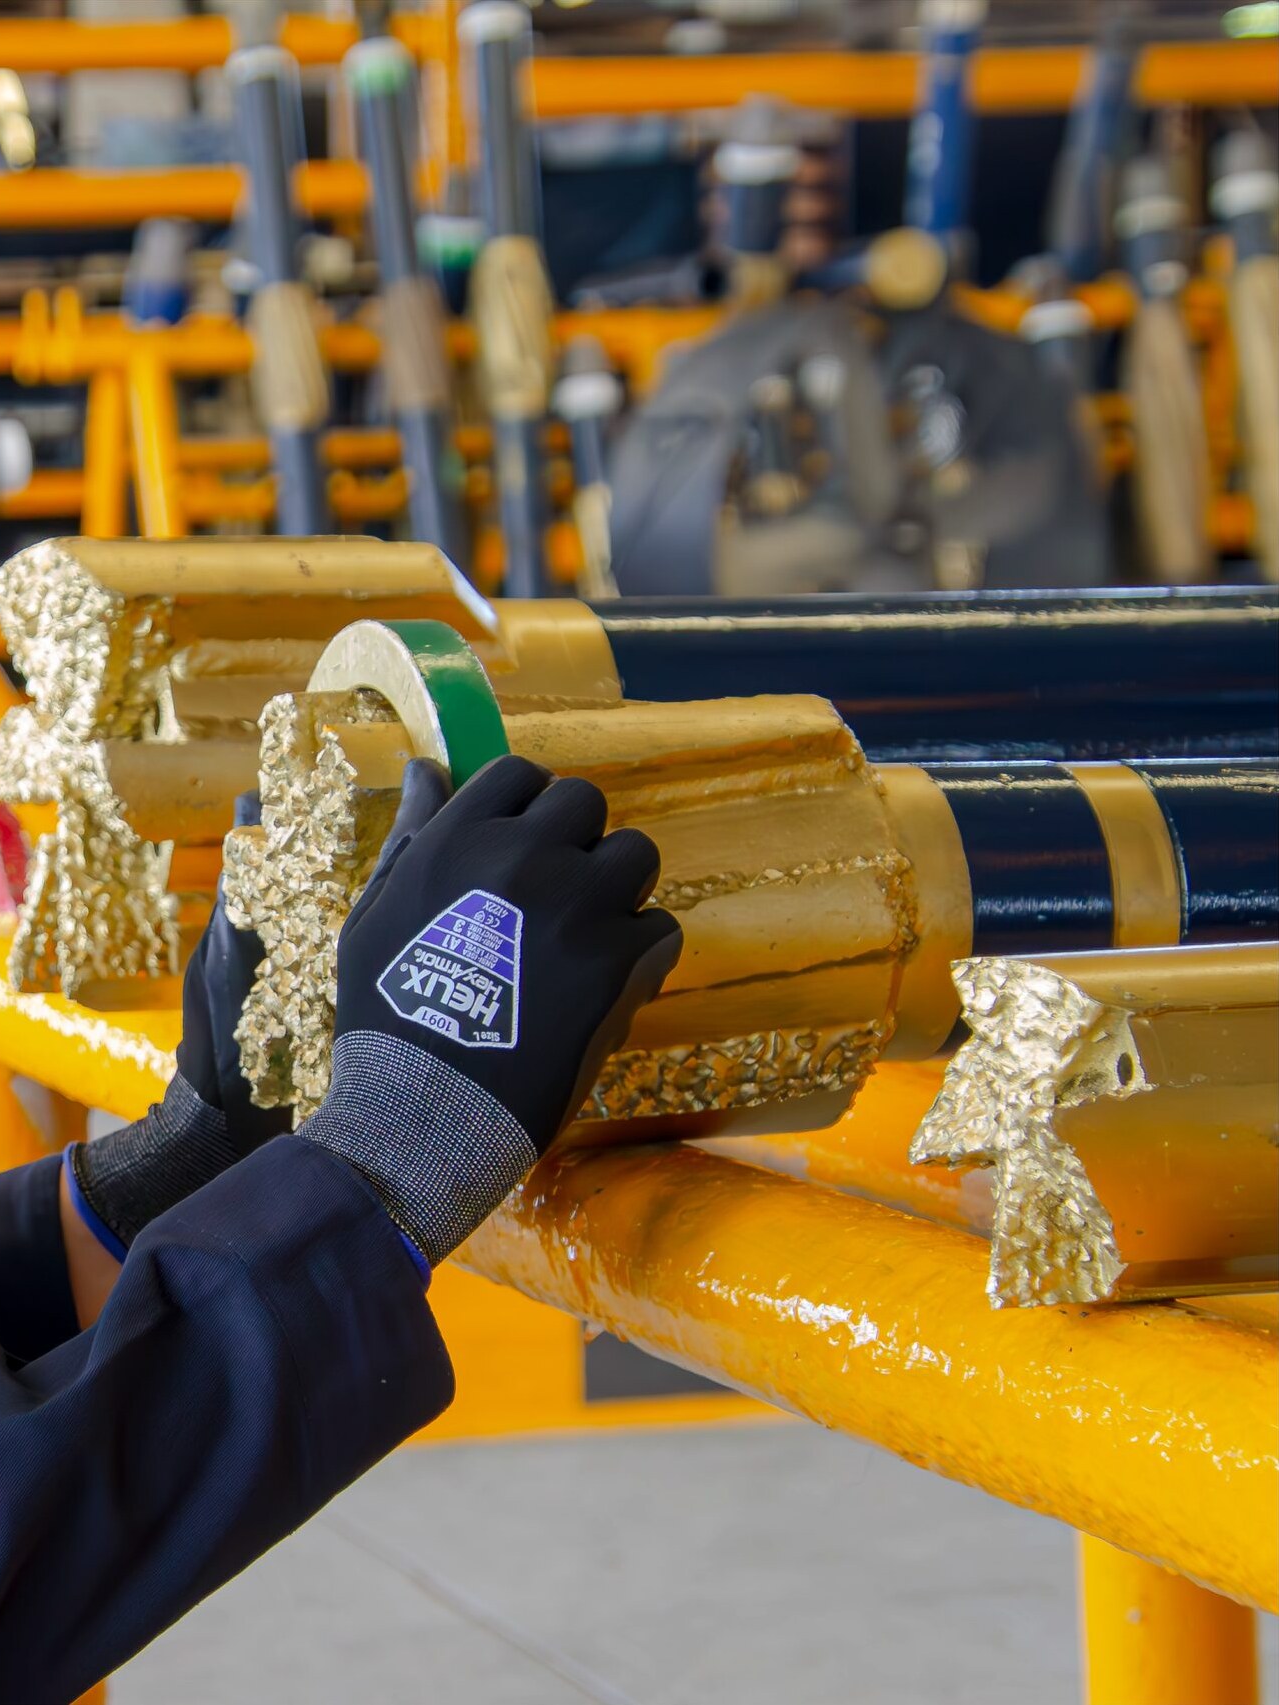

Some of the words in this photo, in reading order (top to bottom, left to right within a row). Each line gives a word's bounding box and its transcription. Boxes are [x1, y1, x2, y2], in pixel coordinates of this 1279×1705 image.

[482, 900, 509, 919] 4122X
[452, 919, 466, 933] 3
[467, 923, 504, 945] PUNCTURE
[441, 934, 462, 951] A1
[464, 941, 485, 956] LEVEL
[484, 952, 499, 965] CUT
[421, 1010, 452, 1032] 1091
[473, 1031, 480, 1041] L
[480, 1031, 501, 1042] Size
